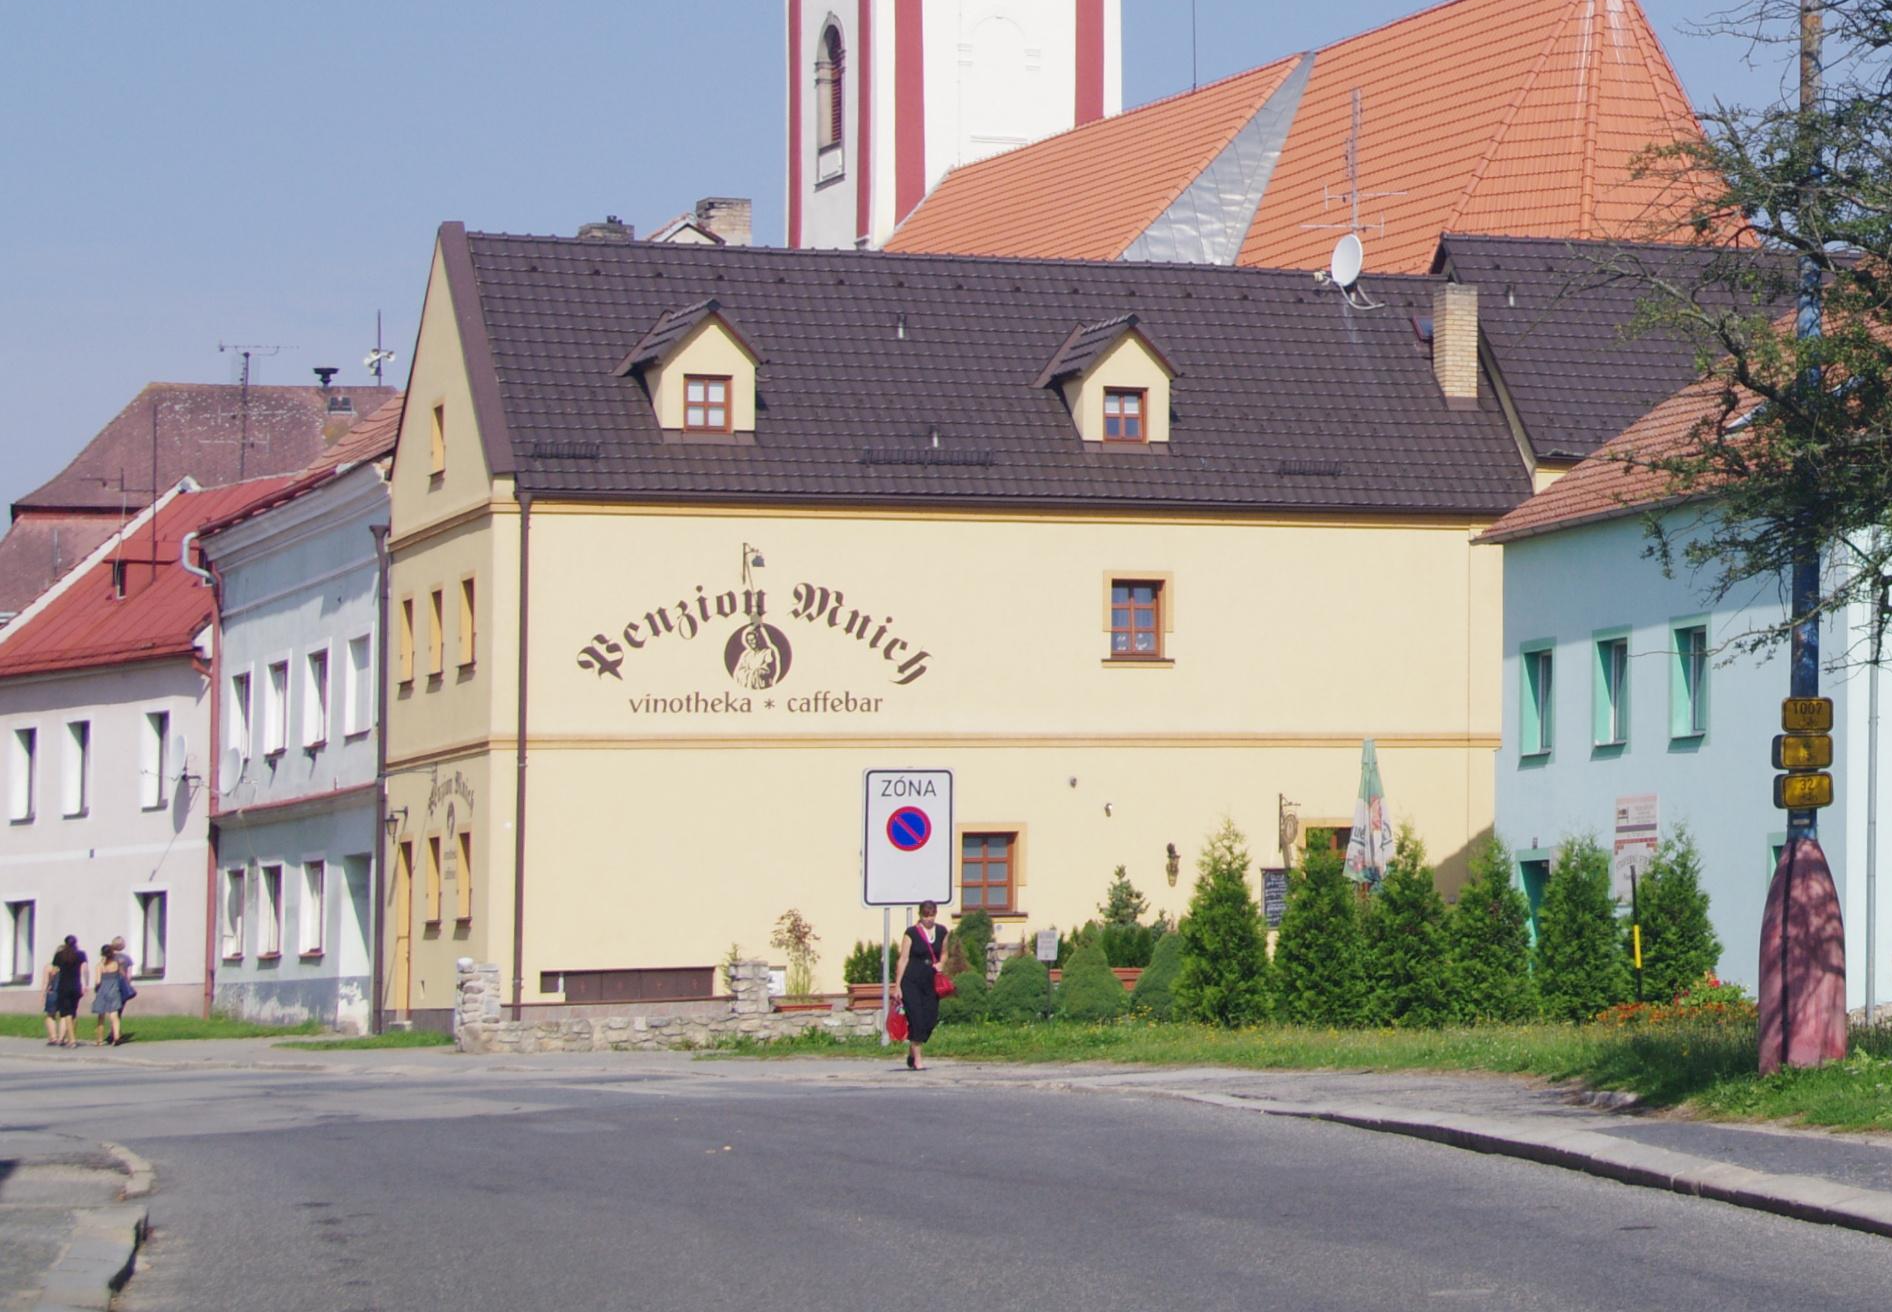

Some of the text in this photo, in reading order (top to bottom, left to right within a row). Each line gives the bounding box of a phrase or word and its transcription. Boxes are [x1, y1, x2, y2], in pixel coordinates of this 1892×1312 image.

[577, 582, 932, 685] Penzion Mnich
[629, 690, 883, 714] vinotheka caffebar
[1792, 702, 1823, 715] 1007
[881, 776, 937, 797] ZÓNA
[1800, 778, 1815, 791] 32
